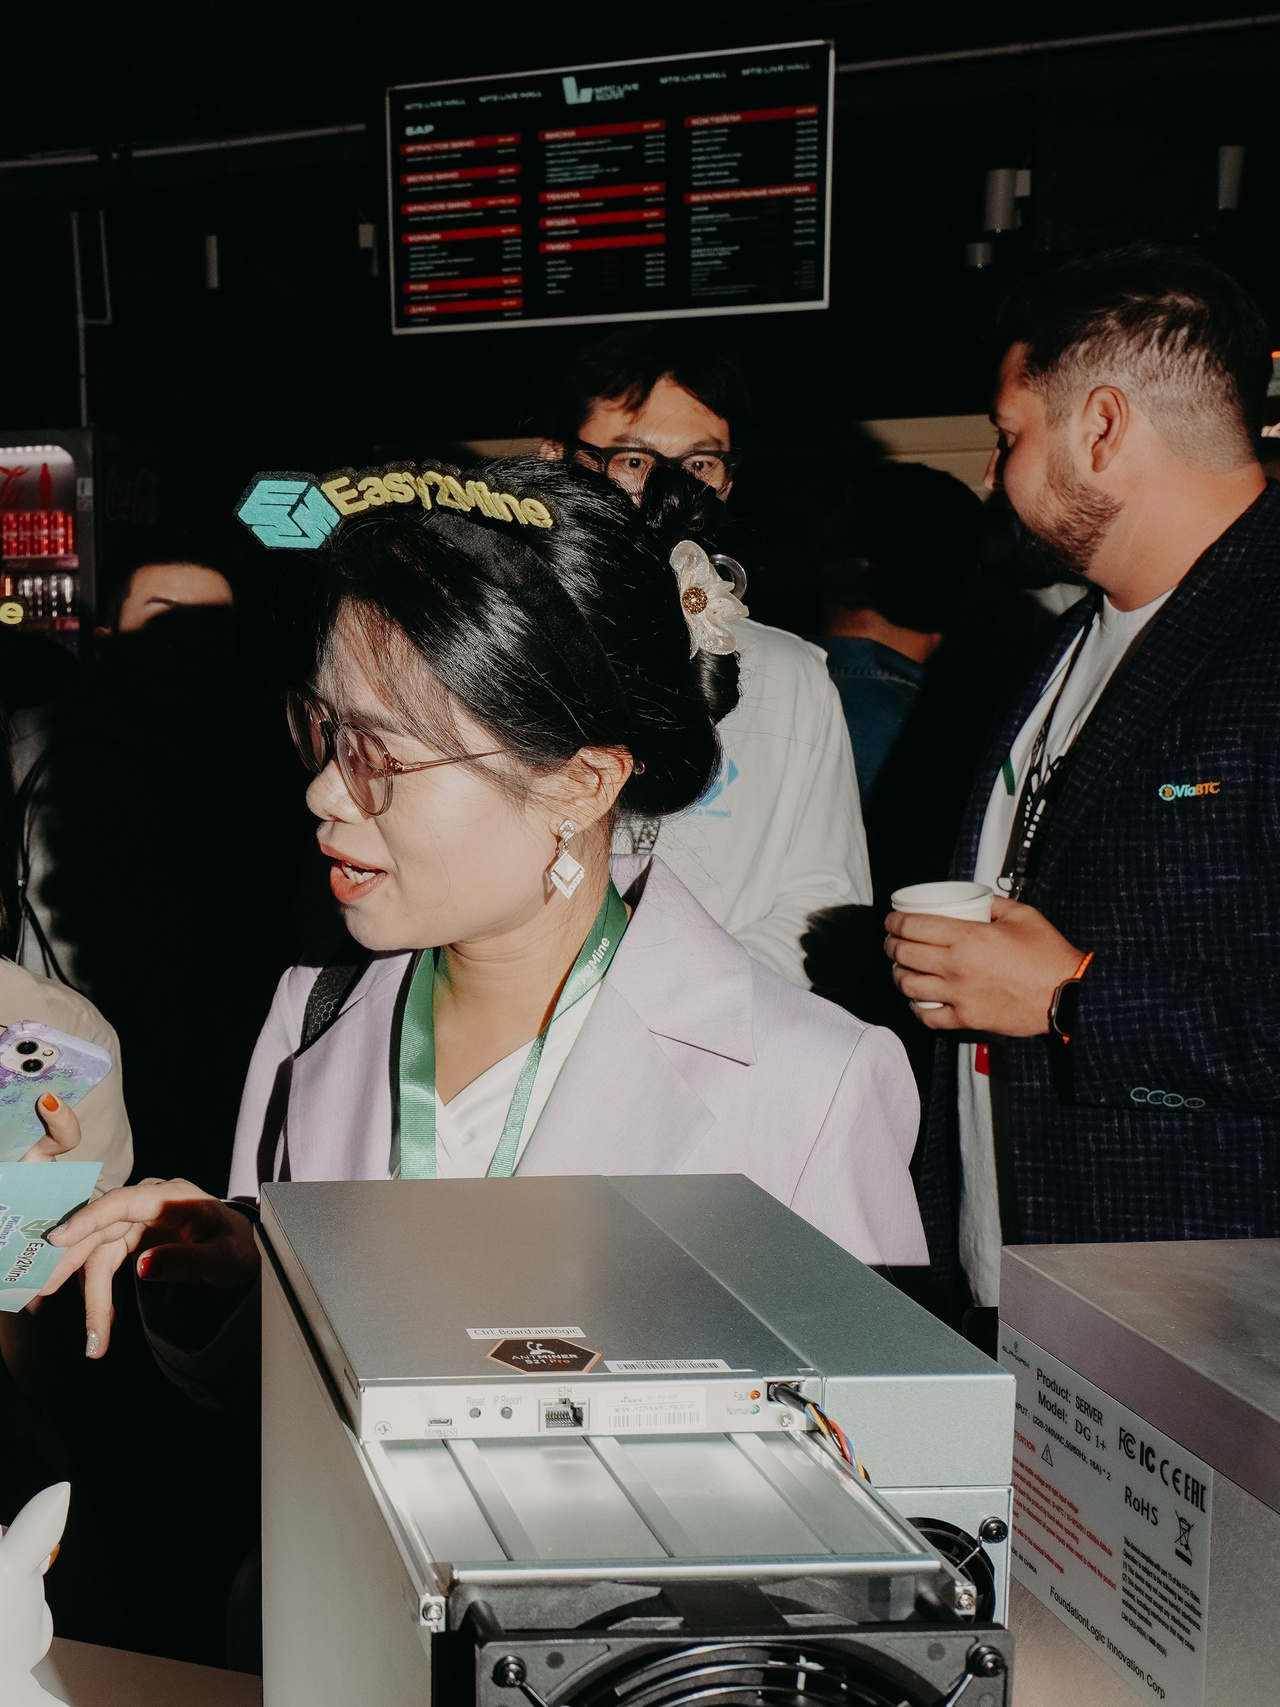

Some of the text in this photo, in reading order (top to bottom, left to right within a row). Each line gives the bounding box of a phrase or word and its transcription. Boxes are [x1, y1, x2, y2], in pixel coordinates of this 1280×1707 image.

[320, 471, 554, 528] Easy2Mine
[1175, 782, 1221, 798] ViaBTC
[3, 1240, 45, 1283] Easy2Mine
[511, 1353, 579, 1361] ANTMINER
[466, 1396, 485, 1406] Reset
[493, 1395, 523, 1408] IP Report
[558, 1387, 573, 1396] ETH
[733, 1391, 750, 1401] Fault
[1036, 1366, 1102, 1428] Product: SERVER
[726, 1406, 750, 1416] Normal
[1038, 1389, 1106, 1454] Model: DG 1+
[424, 1428, 458, 1438] Micro USB
[1014, 1428, 1035, 1454] TENTION
[1159, 1454, 1181, 1496] CE
[1124, 1484, 1158, 1529] RoHS
[1050, 1584, 1165, 1702] FoundationLogic Innovation Corp
